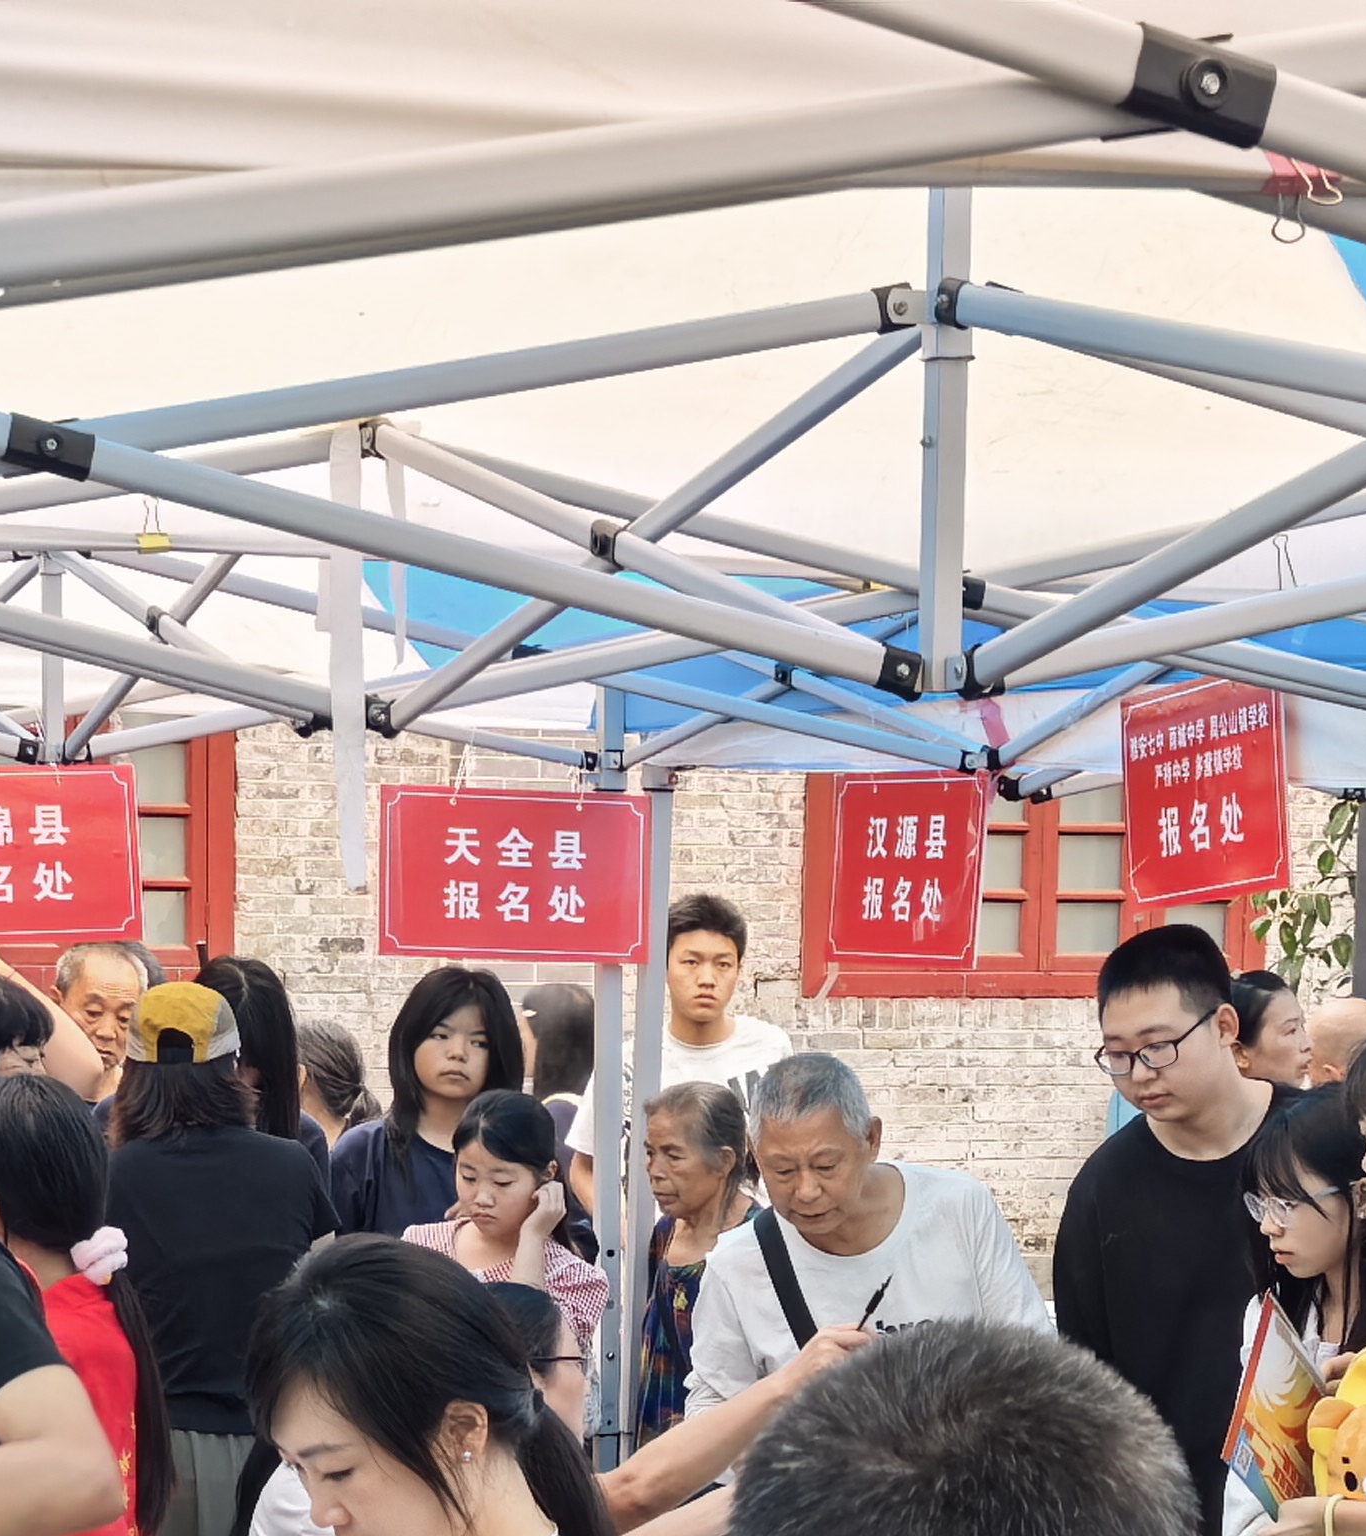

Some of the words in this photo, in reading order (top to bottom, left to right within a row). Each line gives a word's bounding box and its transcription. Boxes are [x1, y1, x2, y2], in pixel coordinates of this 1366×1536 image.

[866, 814, 947, 859] 汉源县
[1157, 791, 1245, 858] 报名处
[444, 827, 587, 871] 天全县
[443, 879, 586, 923] 报名处
[861, 876, 943, 922] 报名处
